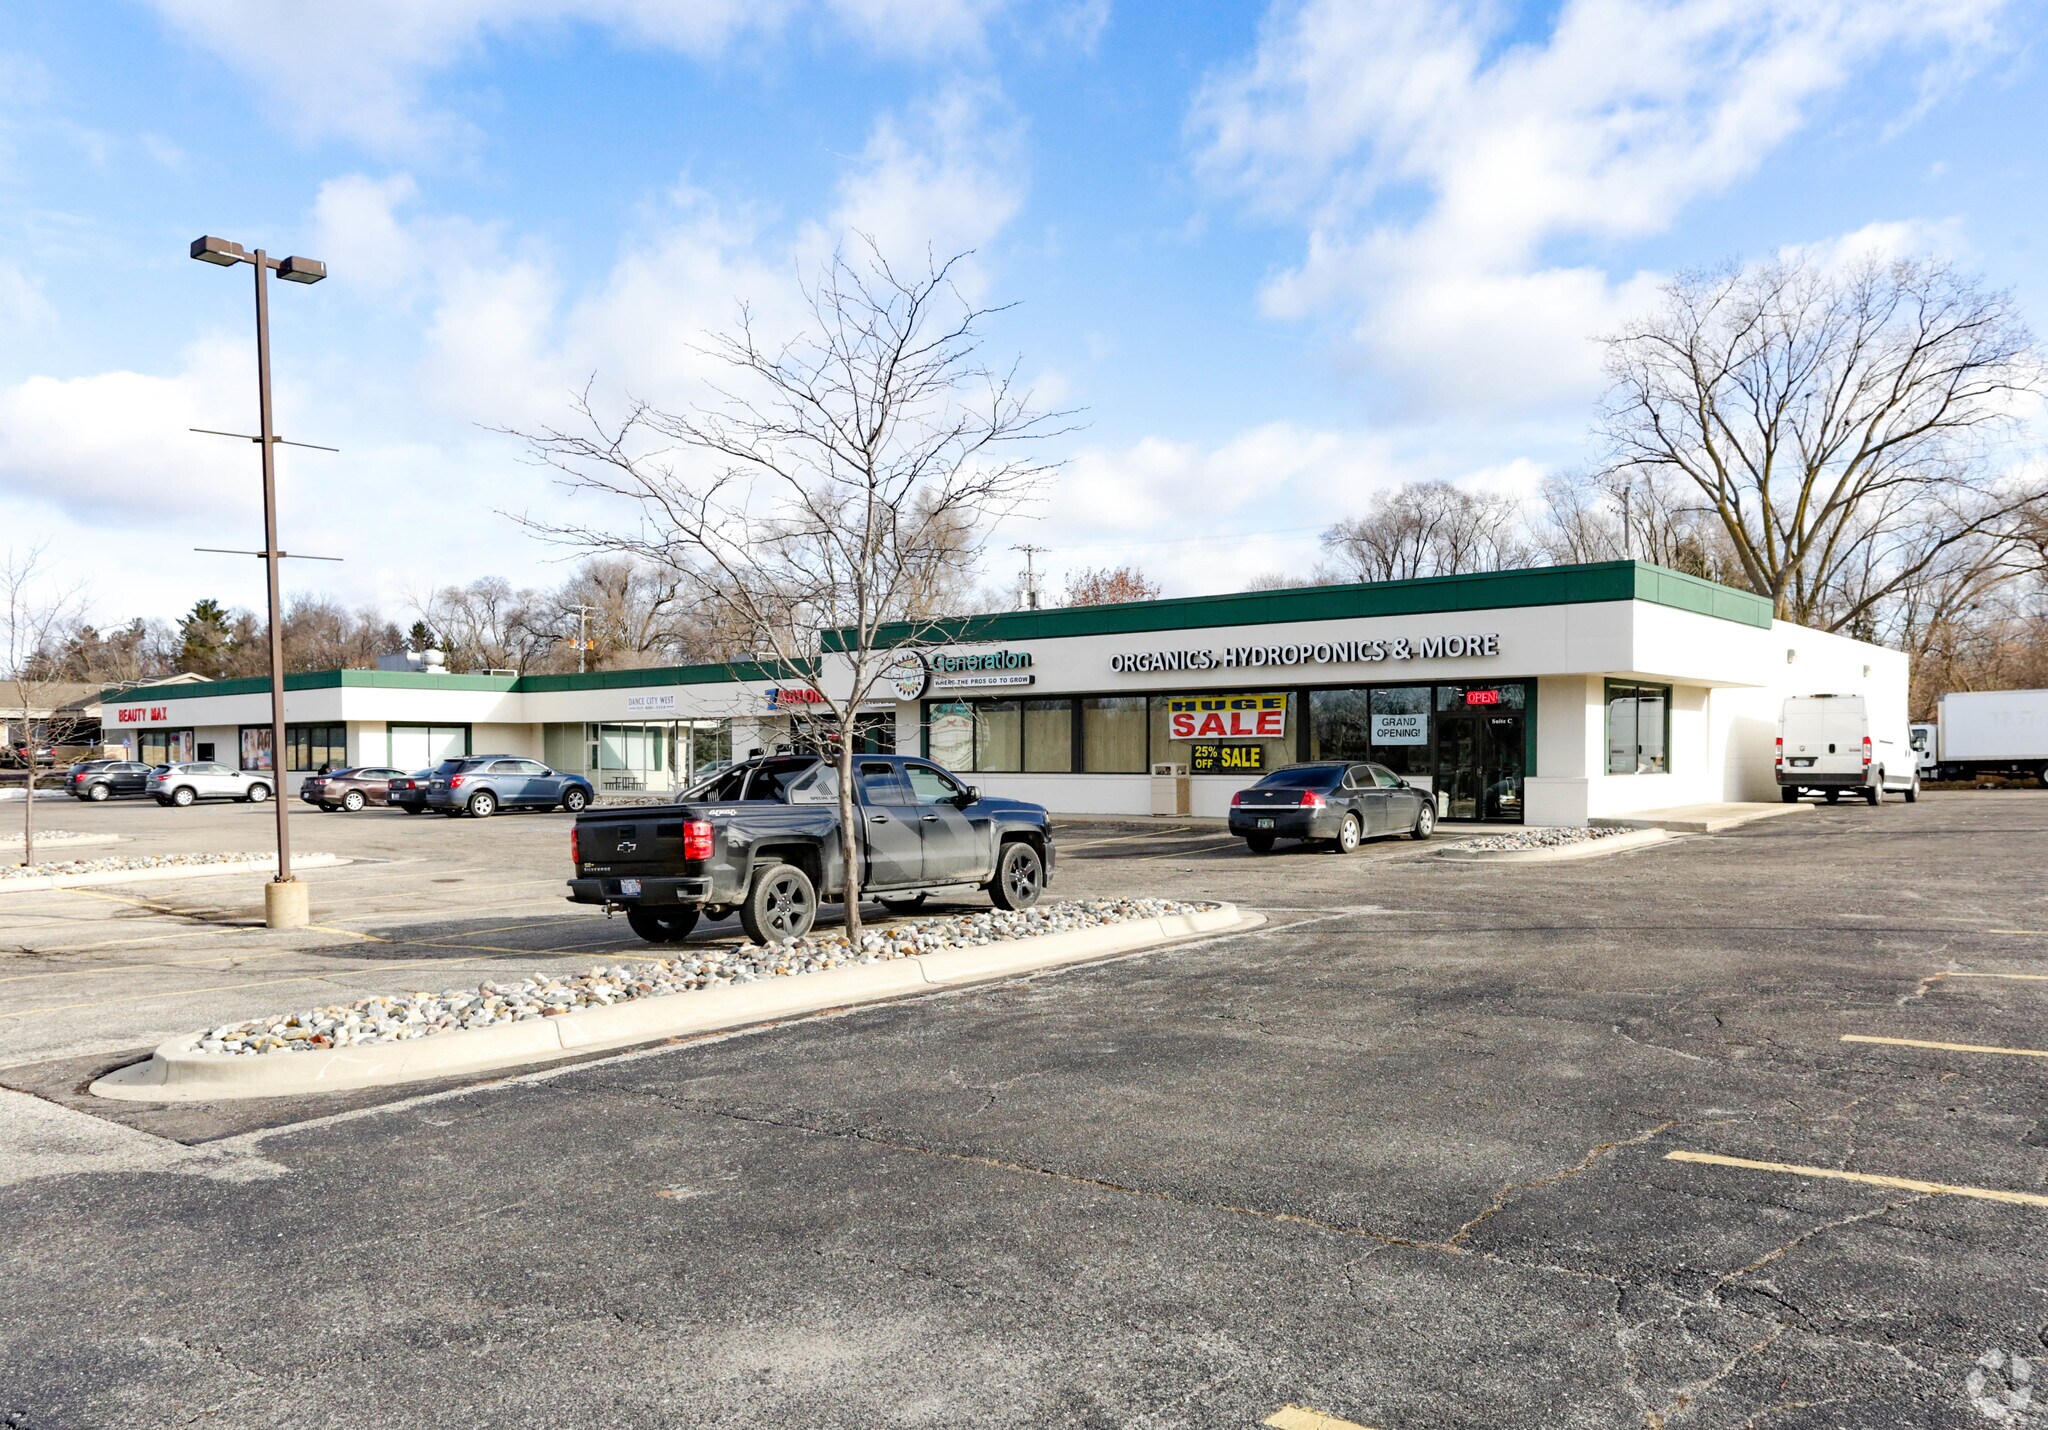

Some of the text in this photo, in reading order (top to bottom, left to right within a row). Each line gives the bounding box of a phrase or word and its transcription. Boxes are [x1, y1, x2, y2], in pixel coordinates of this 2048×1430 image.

[1109, 633, 1500, 673] ORGANICS, HYDROPONICS & MORE
[932, 650, 1031, 672] Generation
[1009, 676, 1028, 684] GROW
[629, 695, 674, 706] DANCE CITY WEST
[1467, 690, 1497, 704] OPEN
[1172, 698, 1281, 712] HUGE
[118, 706, 167, 722] BEAUTY MAX
[1173, 711, 1282, 737] SALE
[1382, 718, 1416, 727] GRAND
[1377, 728, 1421, 738] OPENING!
[1195, 746, 1217, 758] 25%
[1221, 747, 1260, 767] SALE
[1195, 759, 1213, 768] OFF
